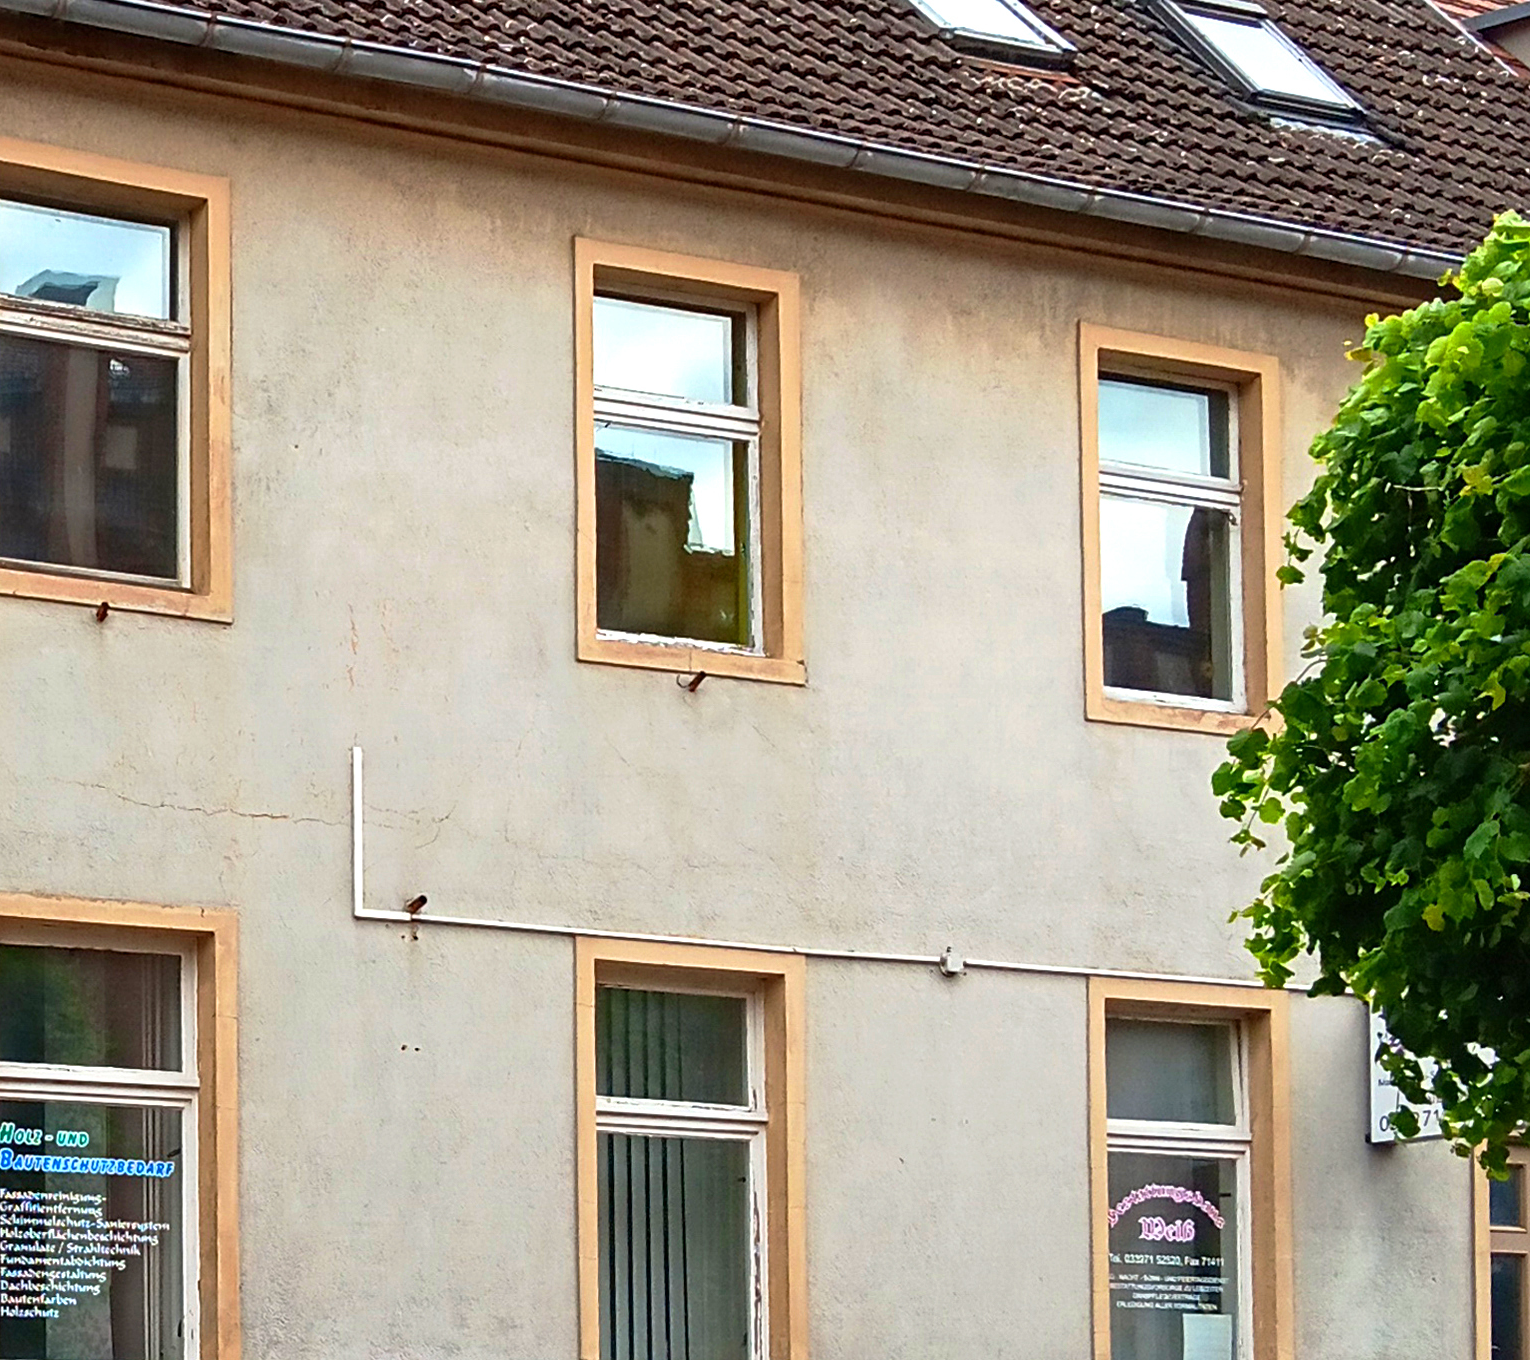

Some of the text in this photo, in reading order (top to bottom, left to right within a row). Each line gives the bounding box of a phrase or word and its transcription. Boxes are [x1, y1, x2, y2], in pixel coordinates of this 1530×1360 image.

[1137, 1216, 1195, 1242] Weiß
[0, 1240, 56, 1254] Granulate
[67, 1242, 141, 1256] Strahltechnik
[0, 1279, 101, 1296] Dachbeschichtung
[0, 1293, 77, 1306] Bautenfarben
[0, 1305, 60, 1318] Holzschutz
